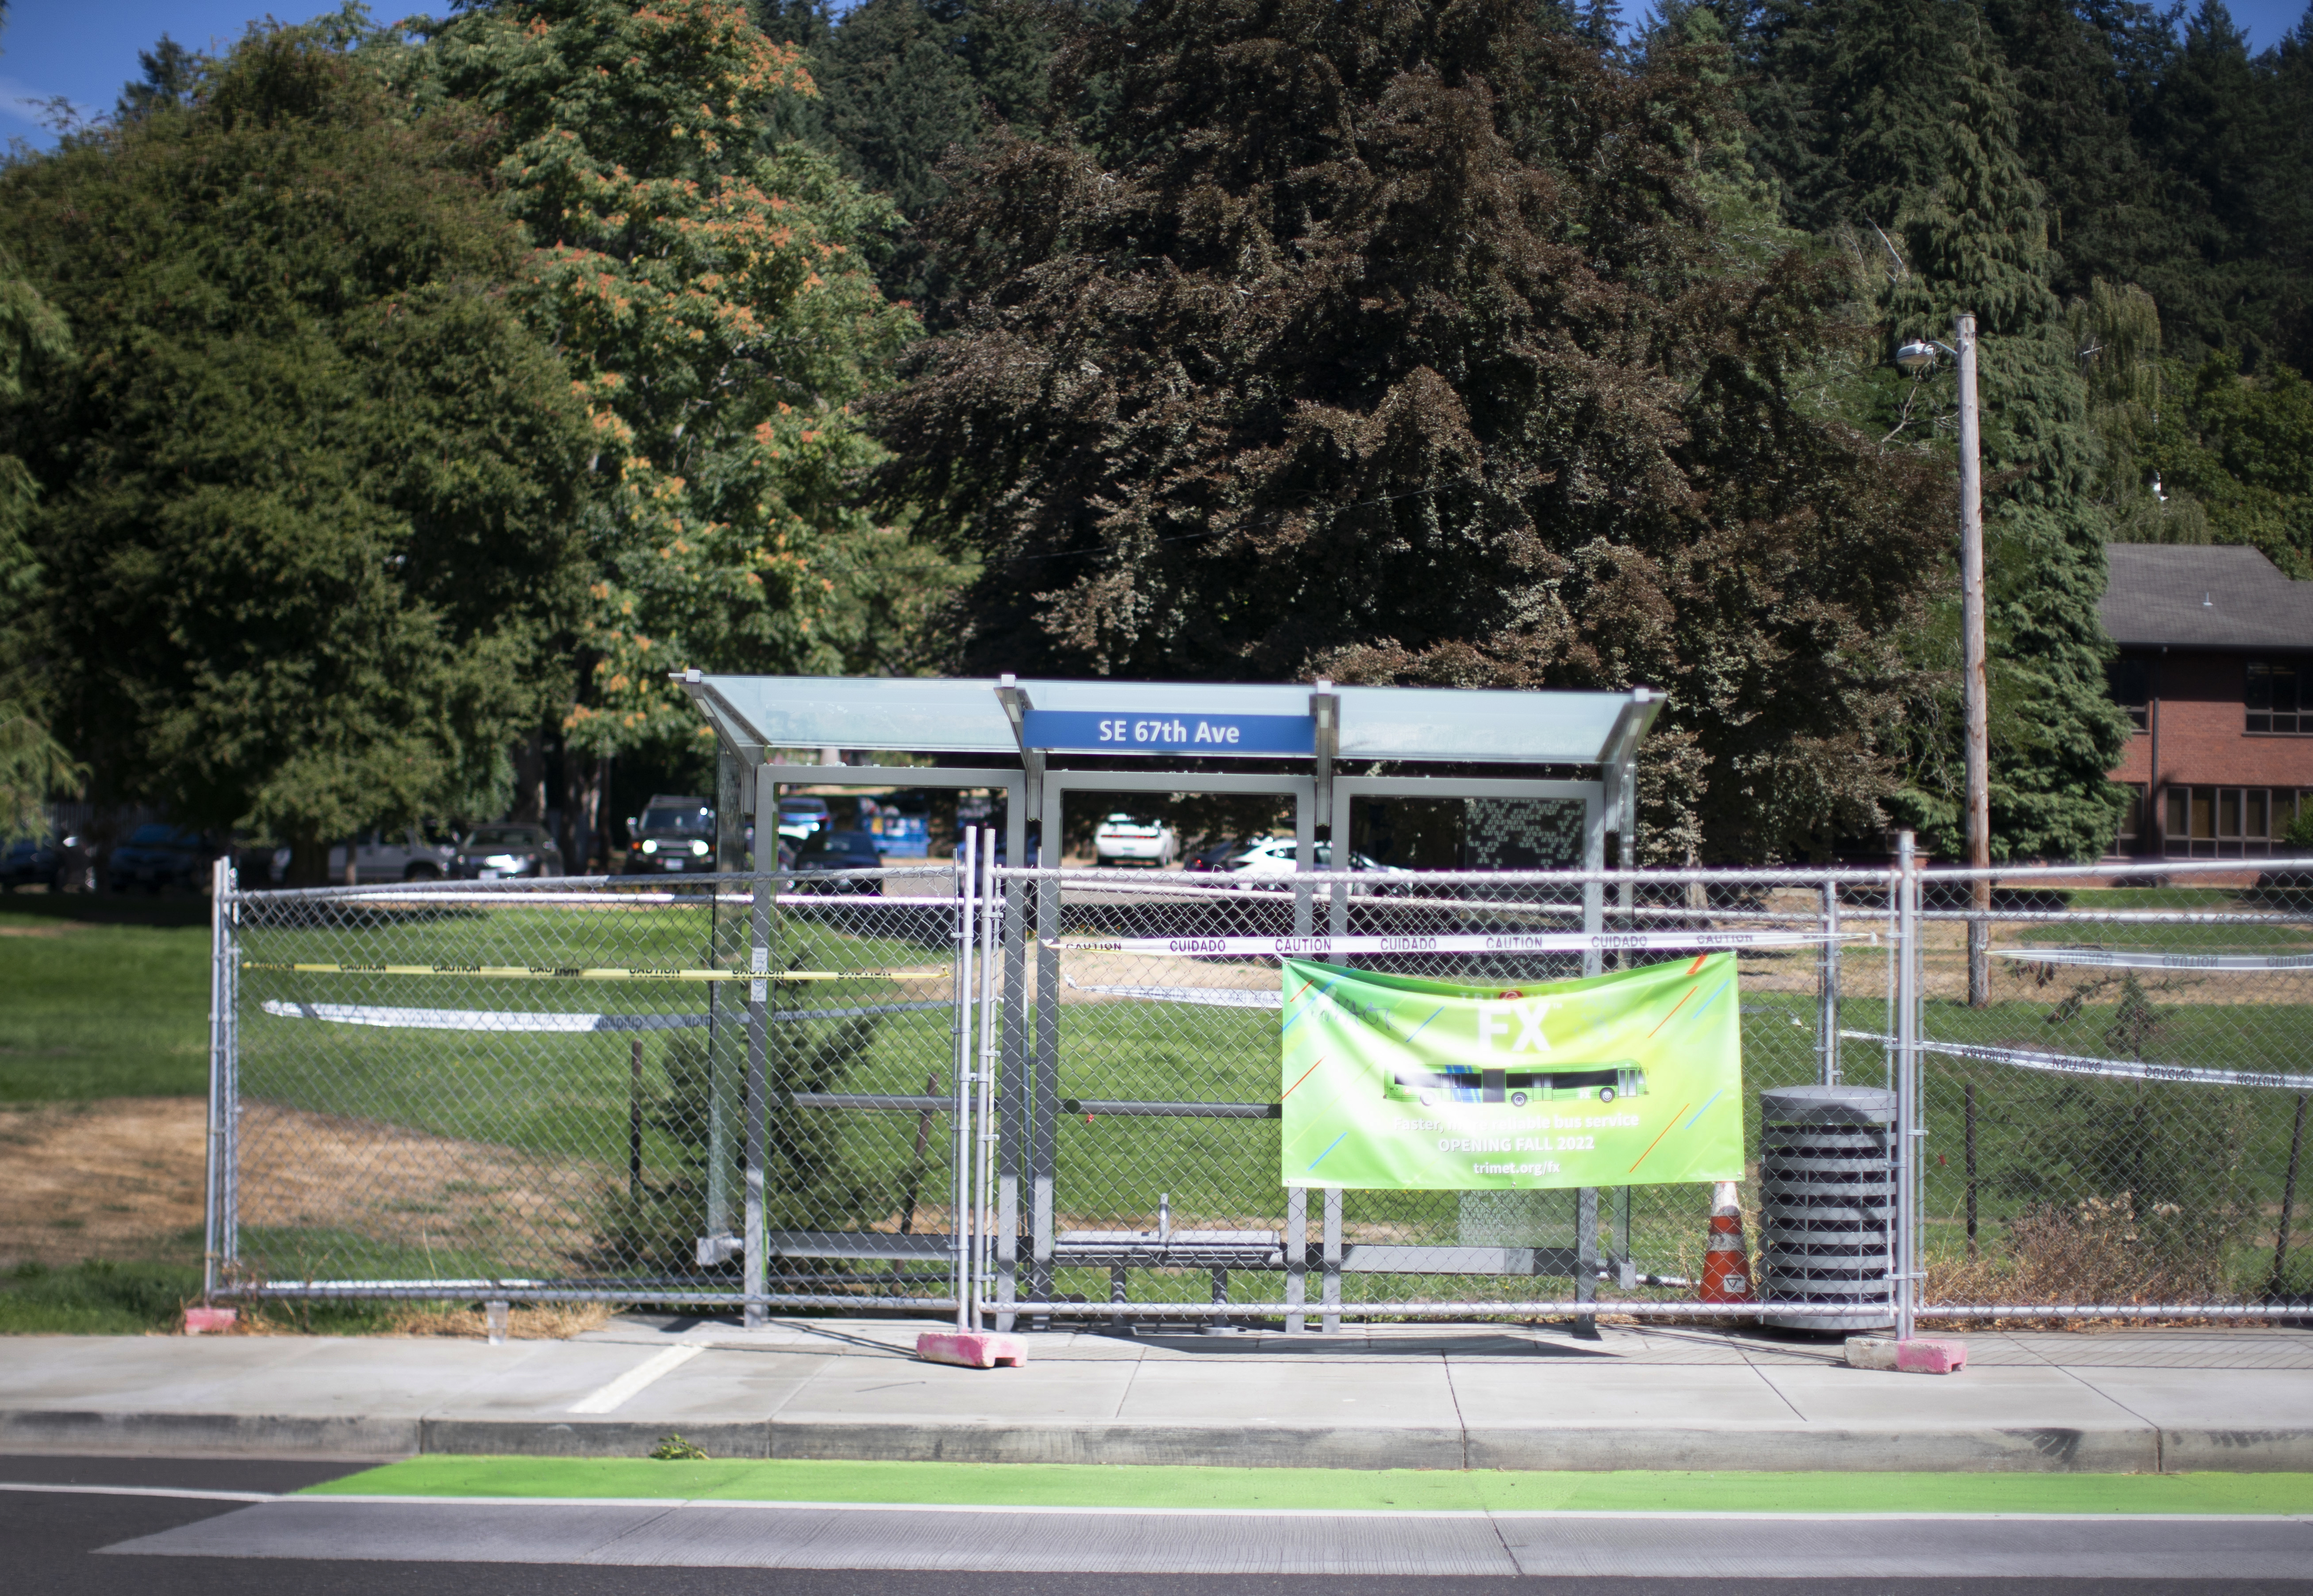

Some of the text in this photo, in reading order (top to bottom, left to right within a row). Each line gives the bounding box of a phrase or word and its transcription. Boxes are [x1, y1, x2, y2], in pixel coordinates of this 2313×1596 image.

[1100, 720, 1239, 743] SE 67th Ave
[1170, 940, 1226, 952] CUIDADO
[1276, 938, 1331, 951] CAUTION
[1380, 937, 1437, 950] CUIDADO
[1486, 936, 1543, 948] CAUTION
[1591, 936, 1648, 947] CUIDADO
[1697, 934, 1753, 944] CAUTION
[1478, 1002, 1552, 1051] FX
[2052, 1058, 2102, 1072] CAUTION
[2236, 1073, 2286, 1087] CAUTION
[1394, 1113, 1640, 1133] Faster, mre reliable bus service
[1438, 1136, 1595, 1152] OPENING FALL 2022
[1473, 1160, 1561, 1177] trimet.org/fx
